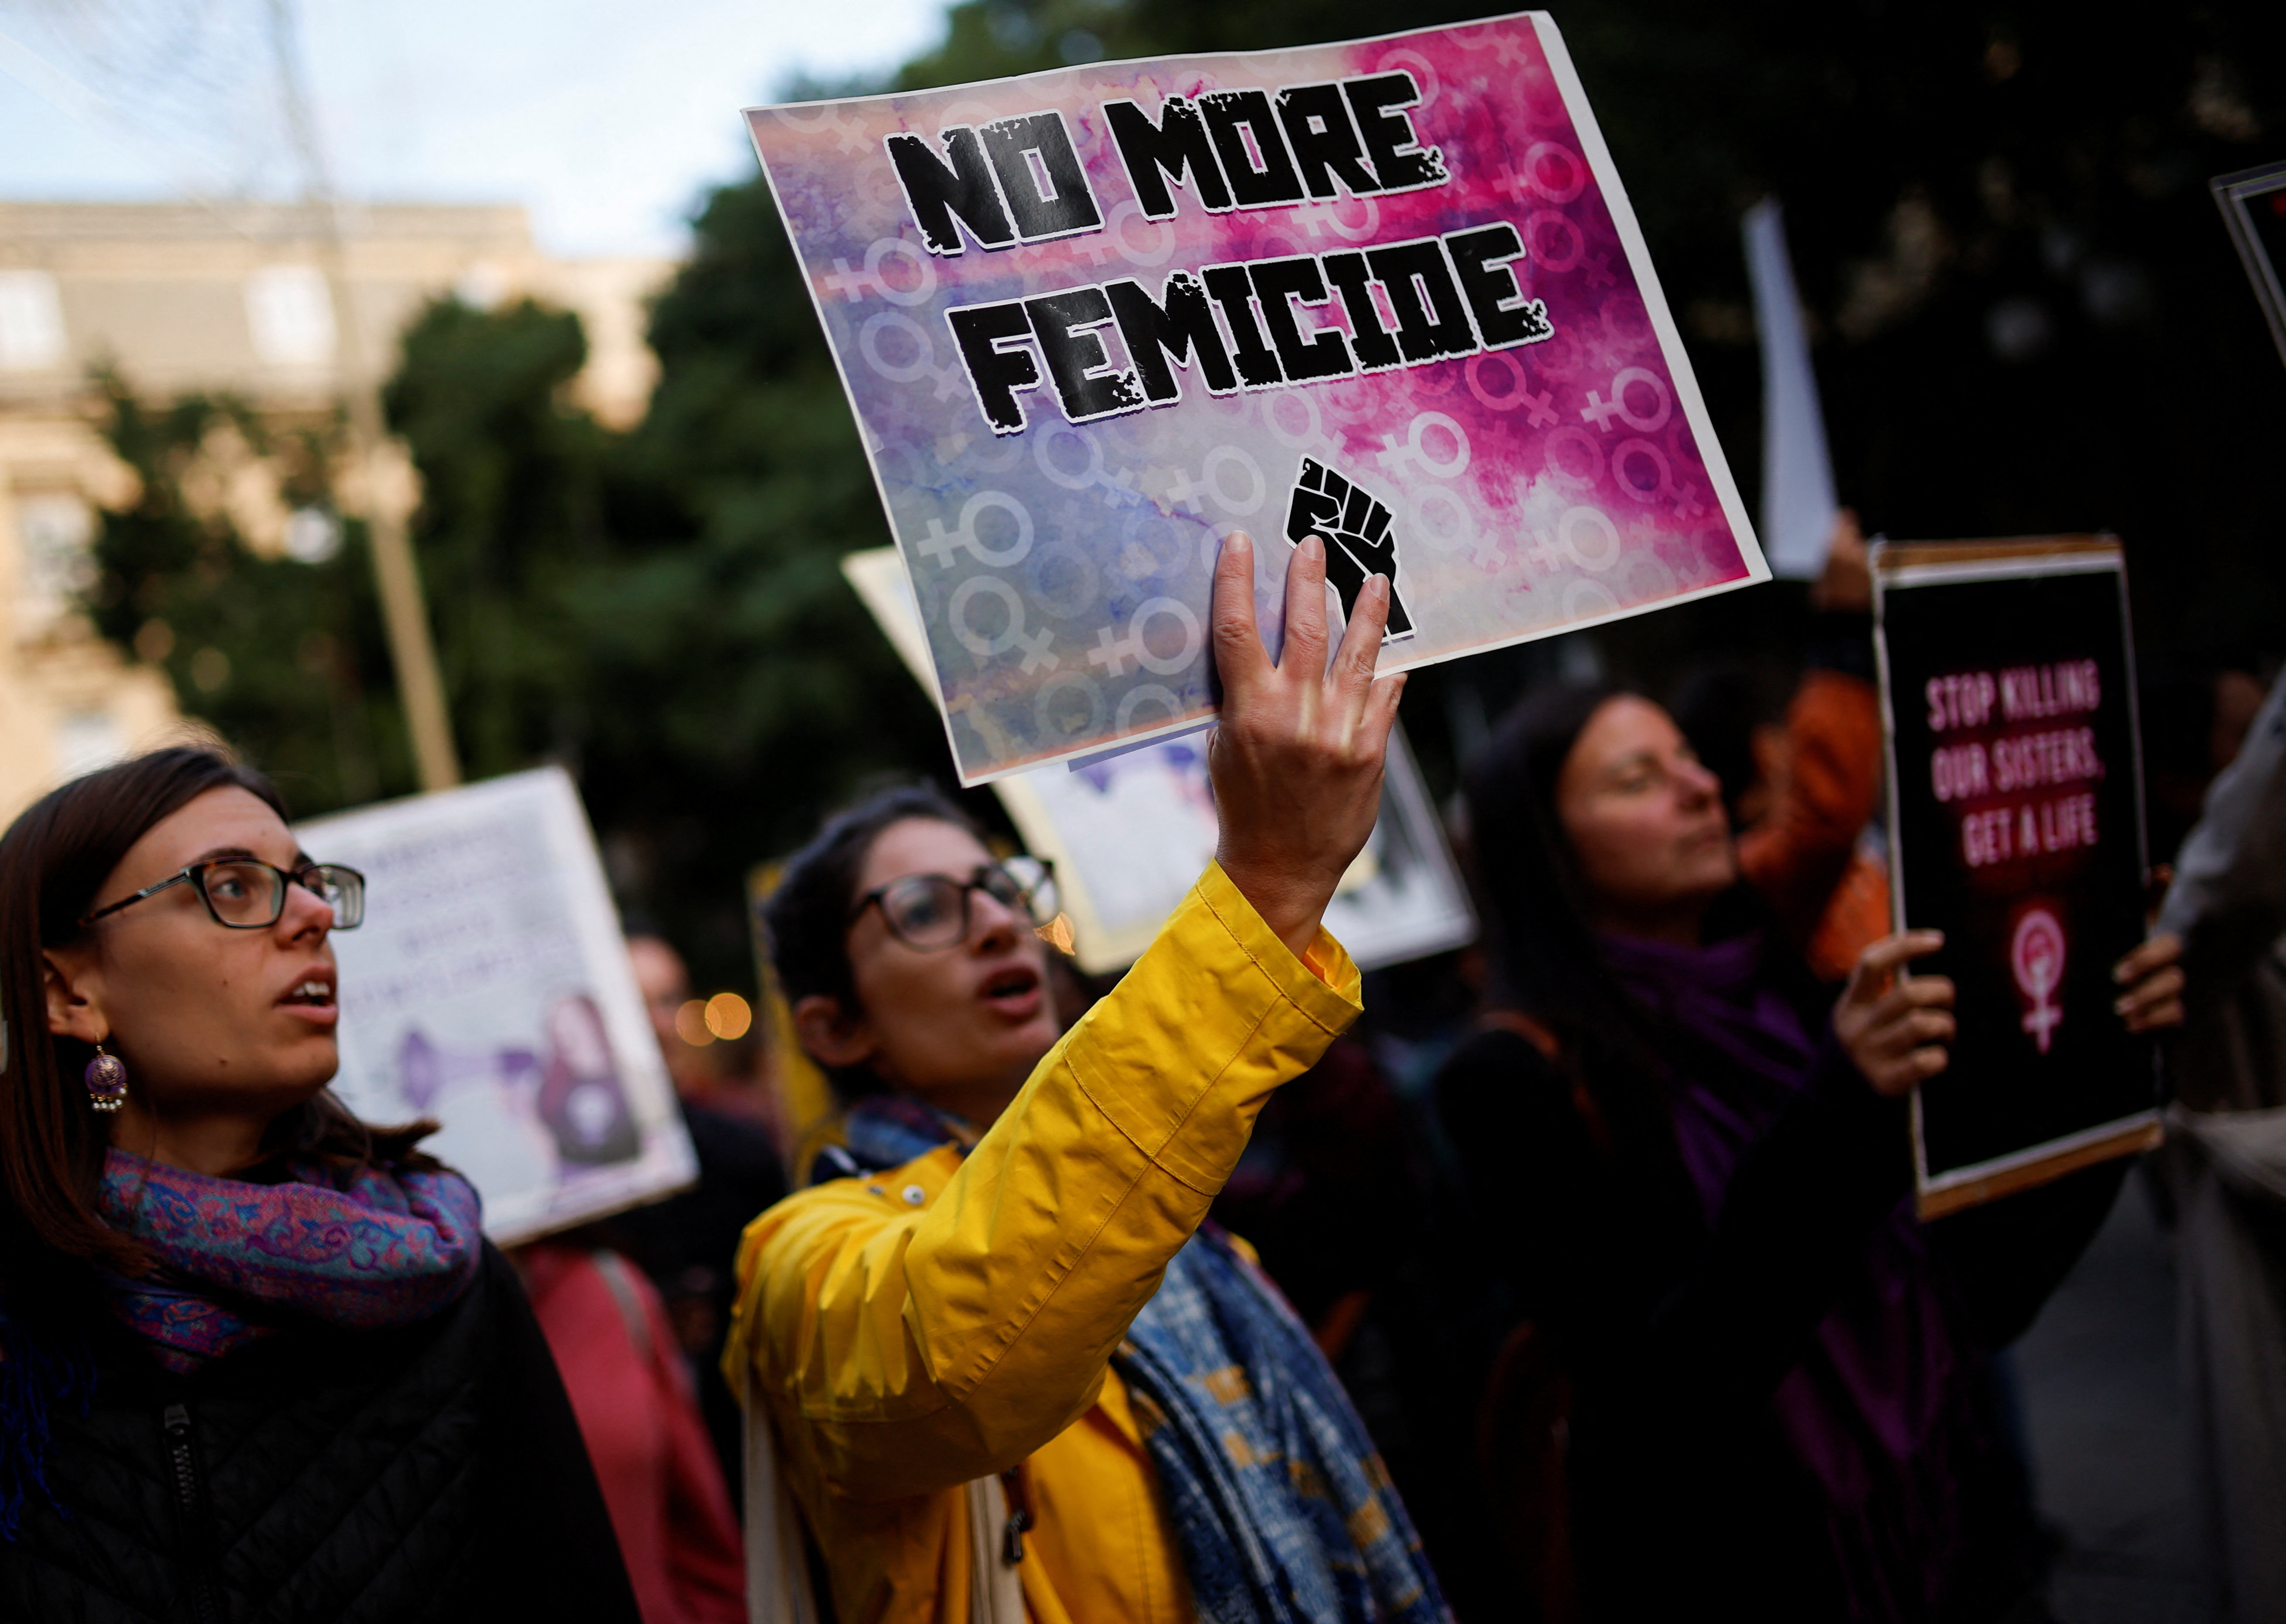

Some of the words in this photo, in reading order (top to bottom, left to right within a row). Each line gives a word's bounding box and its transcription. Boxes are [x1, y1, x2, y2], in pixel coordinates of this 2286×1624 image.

[886, 111, 1103, 256] NO
[1102, 71, 1450, 220] MORE
[944, 222, 1555, 436] FEMICIDE
[1926, 671, 1994, 731] STOP
[2001, 659, 2100, 718] KILLING
[1932, 743, 1988, 801] OUR
[1963, 808, 2011, 867] GET
[2021, 802, 2038, 855] A
[2043, 793, 2097, 851] LIFE
